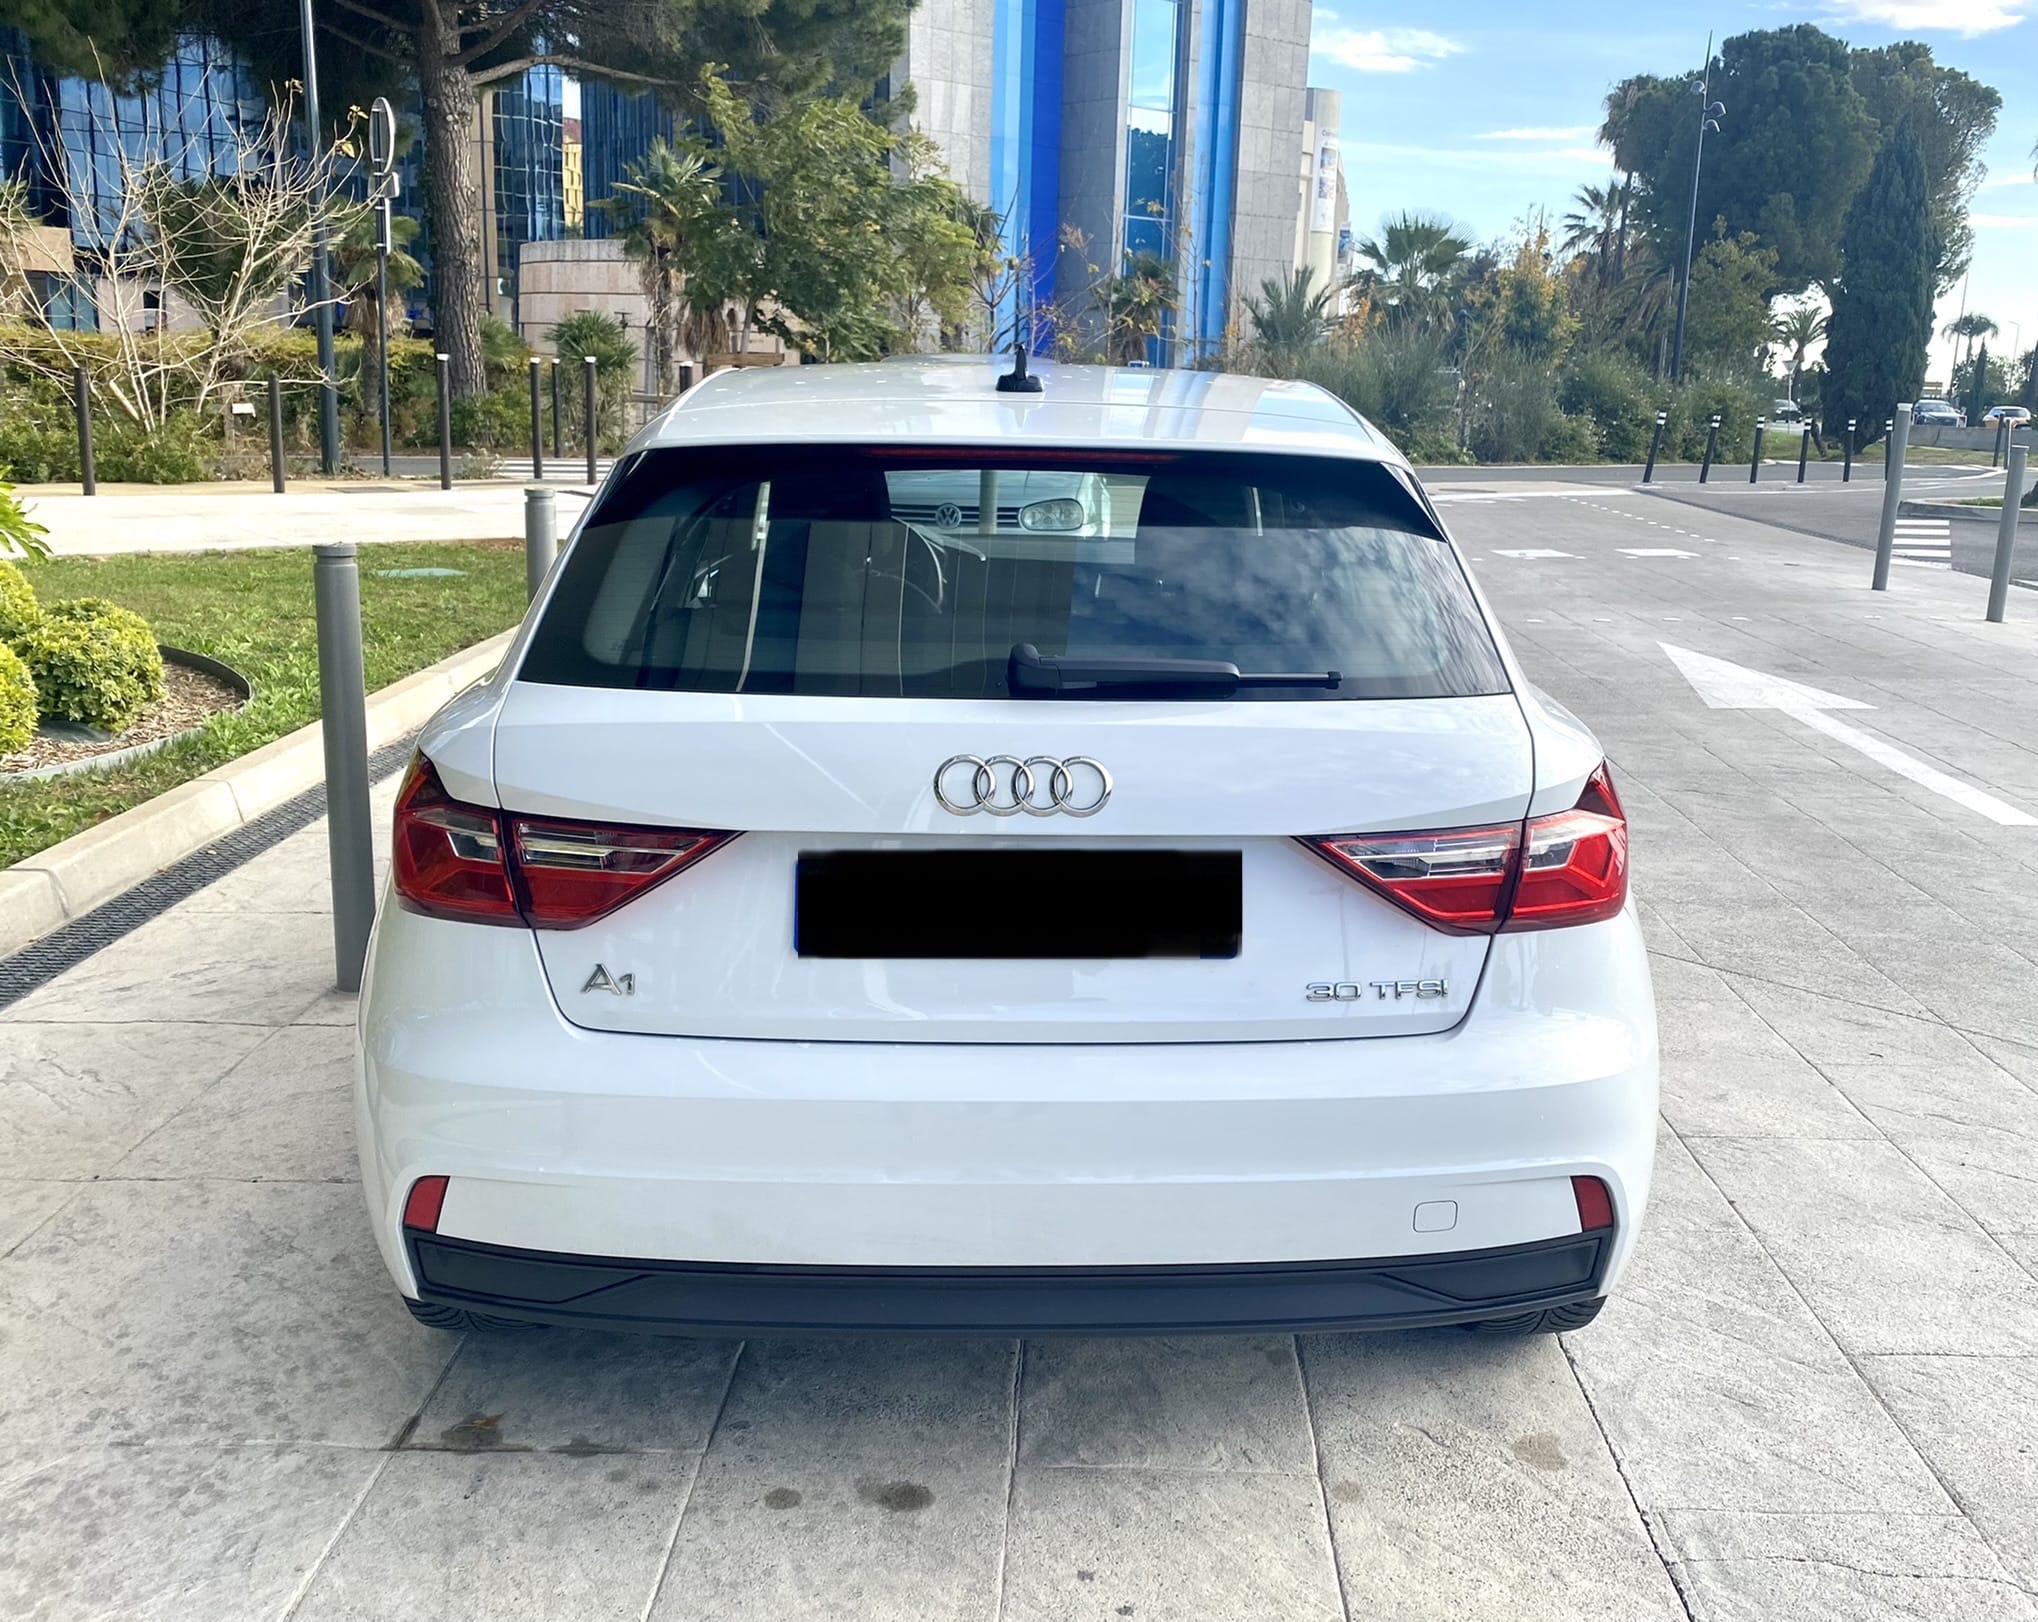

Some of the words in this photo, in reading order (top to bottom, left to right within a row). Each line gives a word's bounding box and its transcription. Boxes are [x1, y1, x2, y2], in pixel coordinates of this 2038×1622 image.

[937, 504, 960, 527] VW
[580, 963, 635, 995] A1
[1306, 980, 1361, 1001] 30
[1369, 979, 1449, 1000] TFSI
